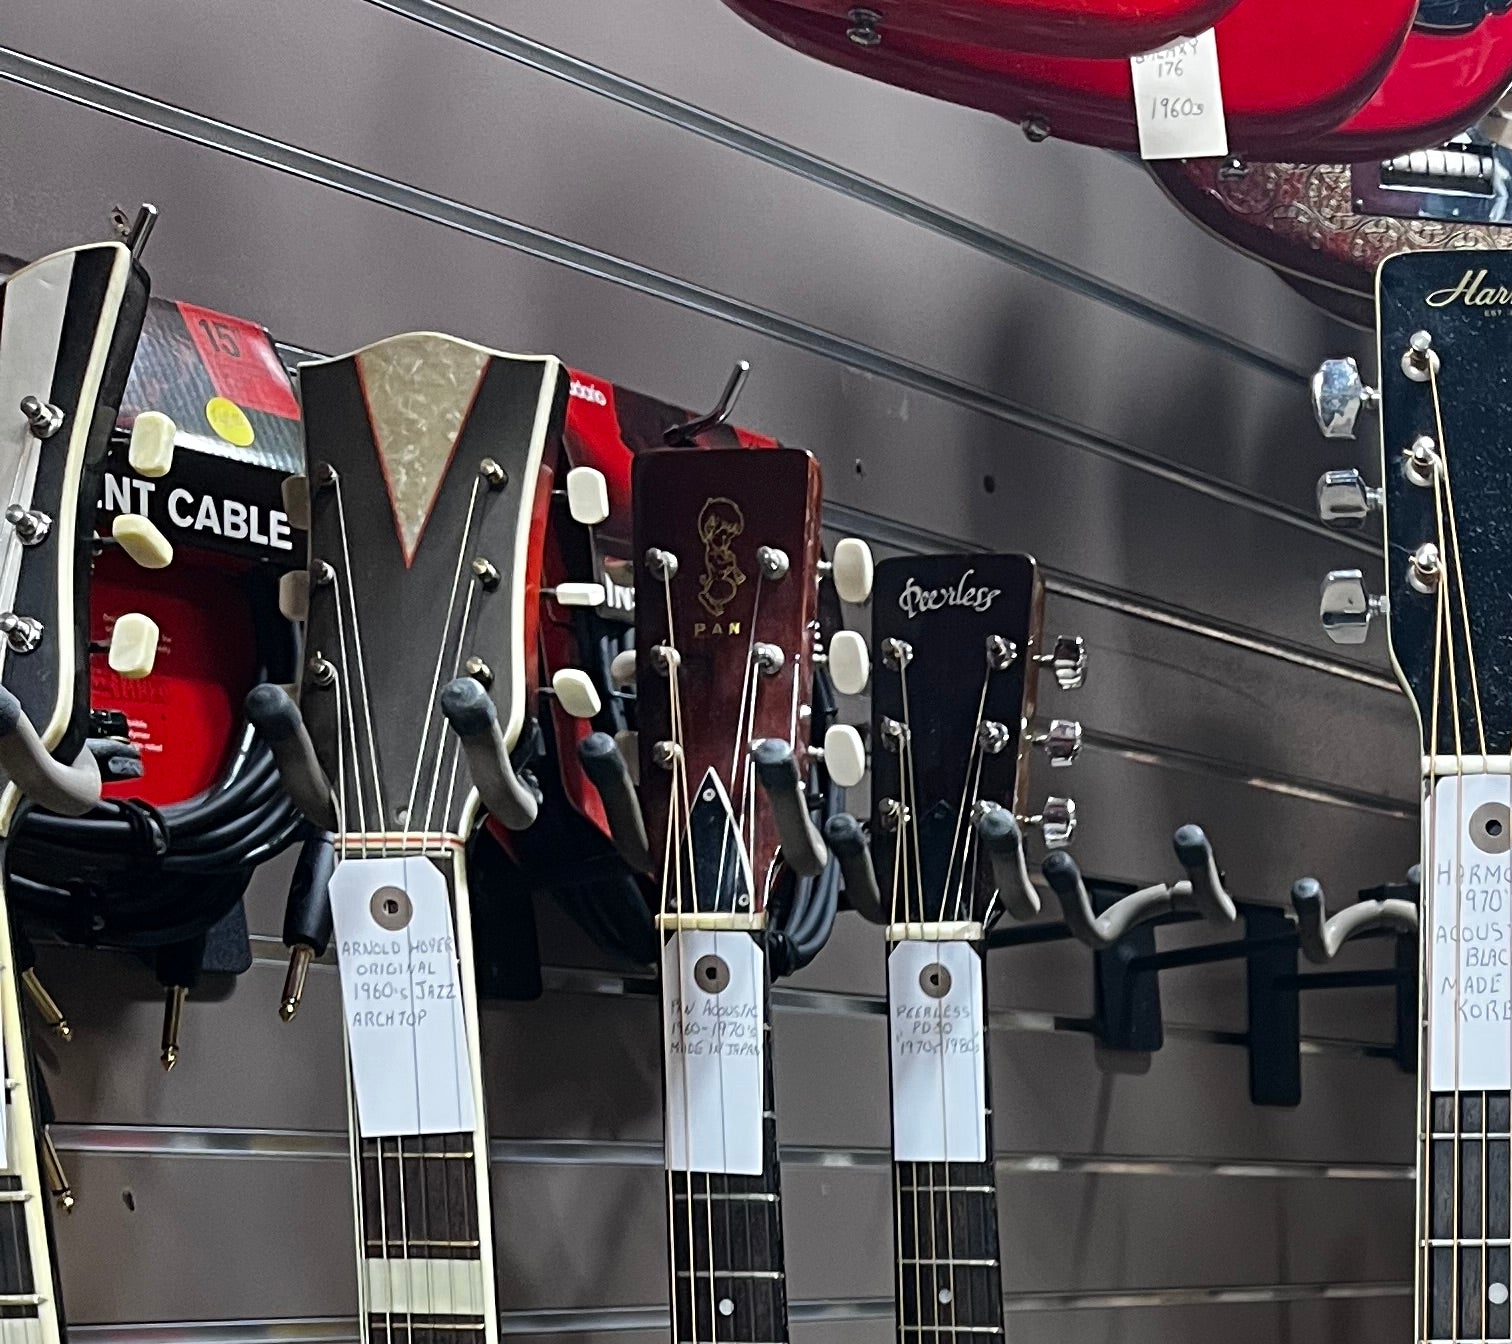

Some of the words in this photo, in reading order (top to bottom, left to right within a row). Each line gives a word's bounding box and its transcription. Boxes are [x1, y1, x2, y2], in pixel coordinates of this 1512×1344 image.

[1158, 59, 1184, 78] 176
[167, 488, 293, 551] CABLE
[898, 568, 1002, 619] Peerless
[694, 621, 741, 637] PAN
[341, 939, 402, 957] ARNOLD
[409, 935, 455, 957] HOYER
[356, 960, 437, 977] ORIGINAL
[414, 981, 458, 1001] JAZZ
[1441, 973, 1502, 995] MADE
